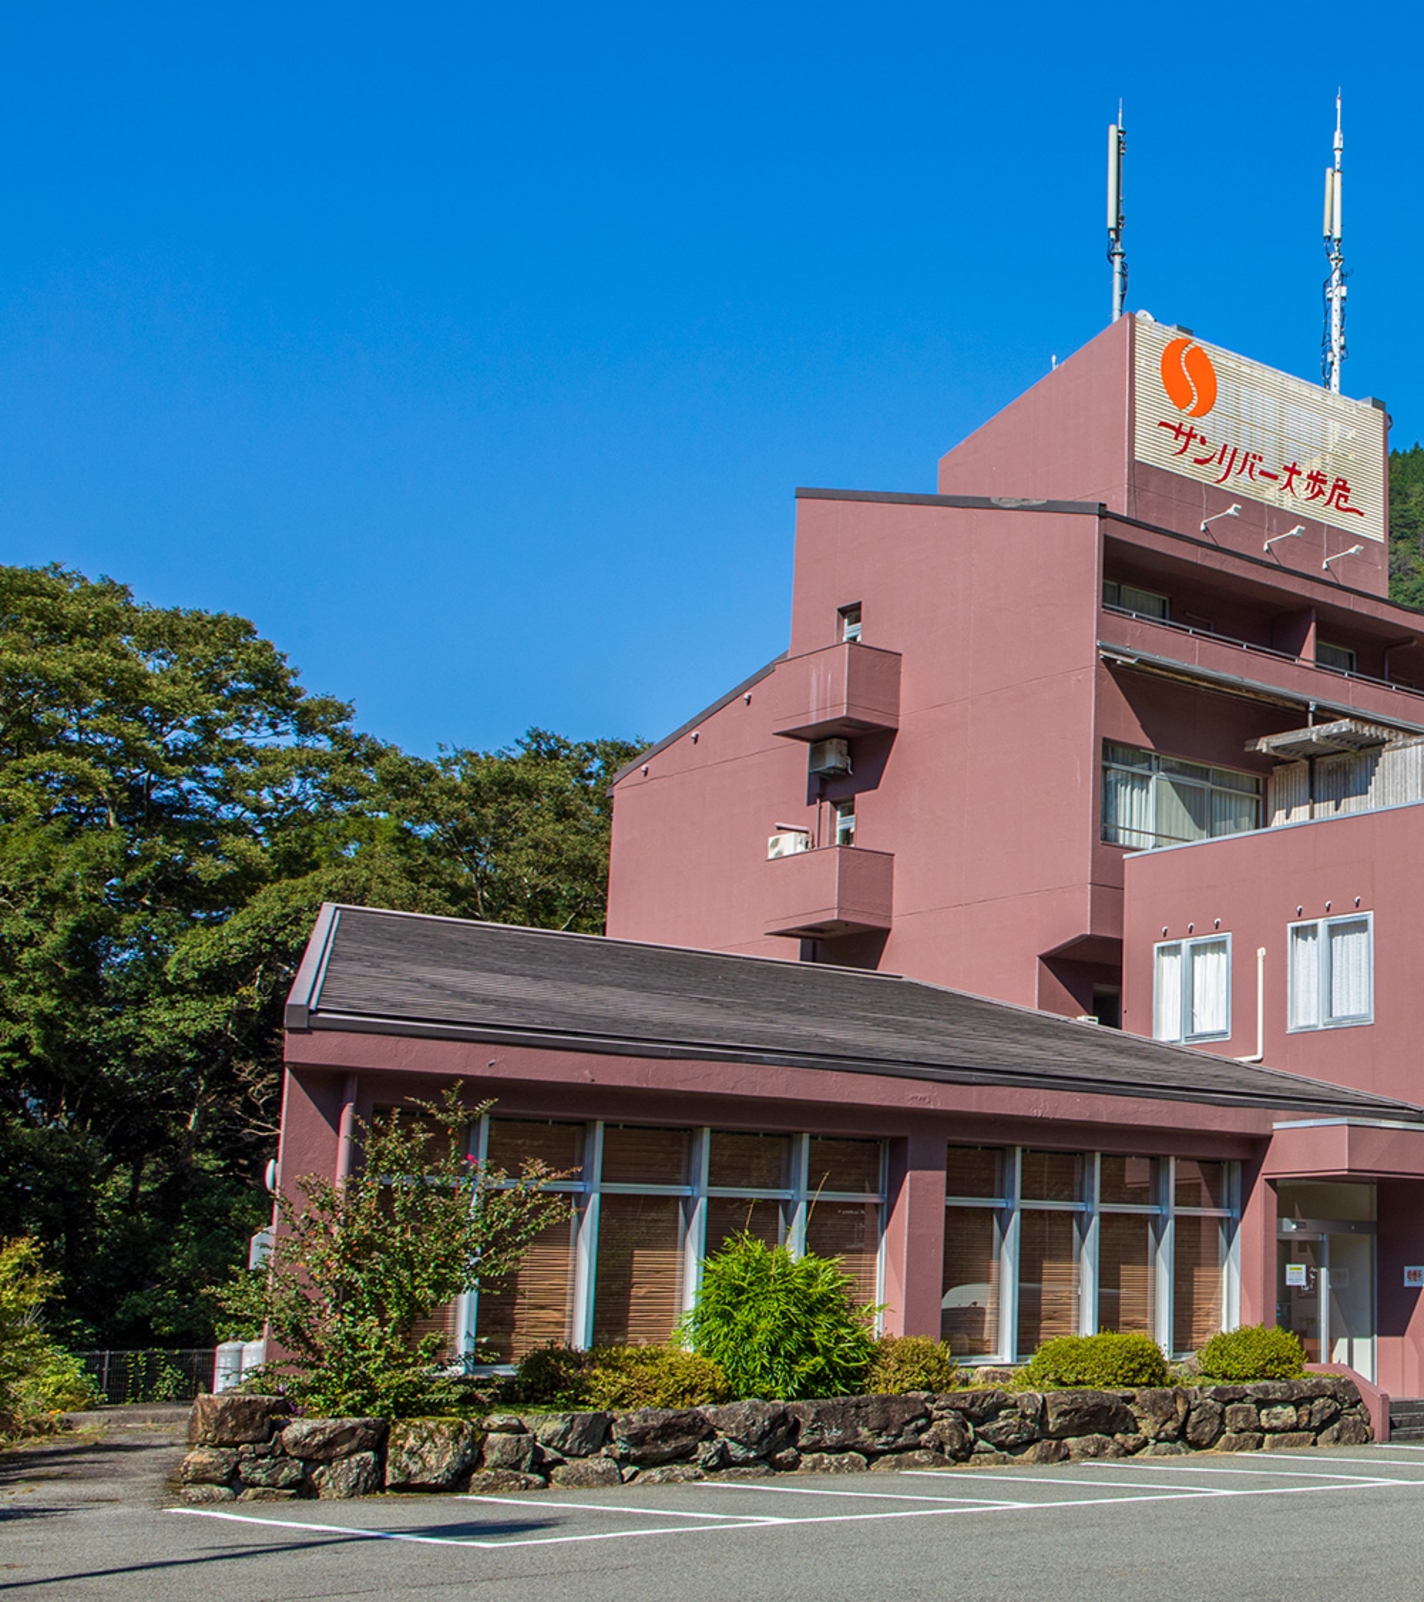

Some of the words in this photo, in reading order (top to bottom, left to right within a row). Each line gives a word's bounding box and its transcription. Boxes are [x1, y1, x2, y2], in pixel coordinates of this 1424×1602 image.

[1158, 421, 1364, 517] サンリバー大歩危
